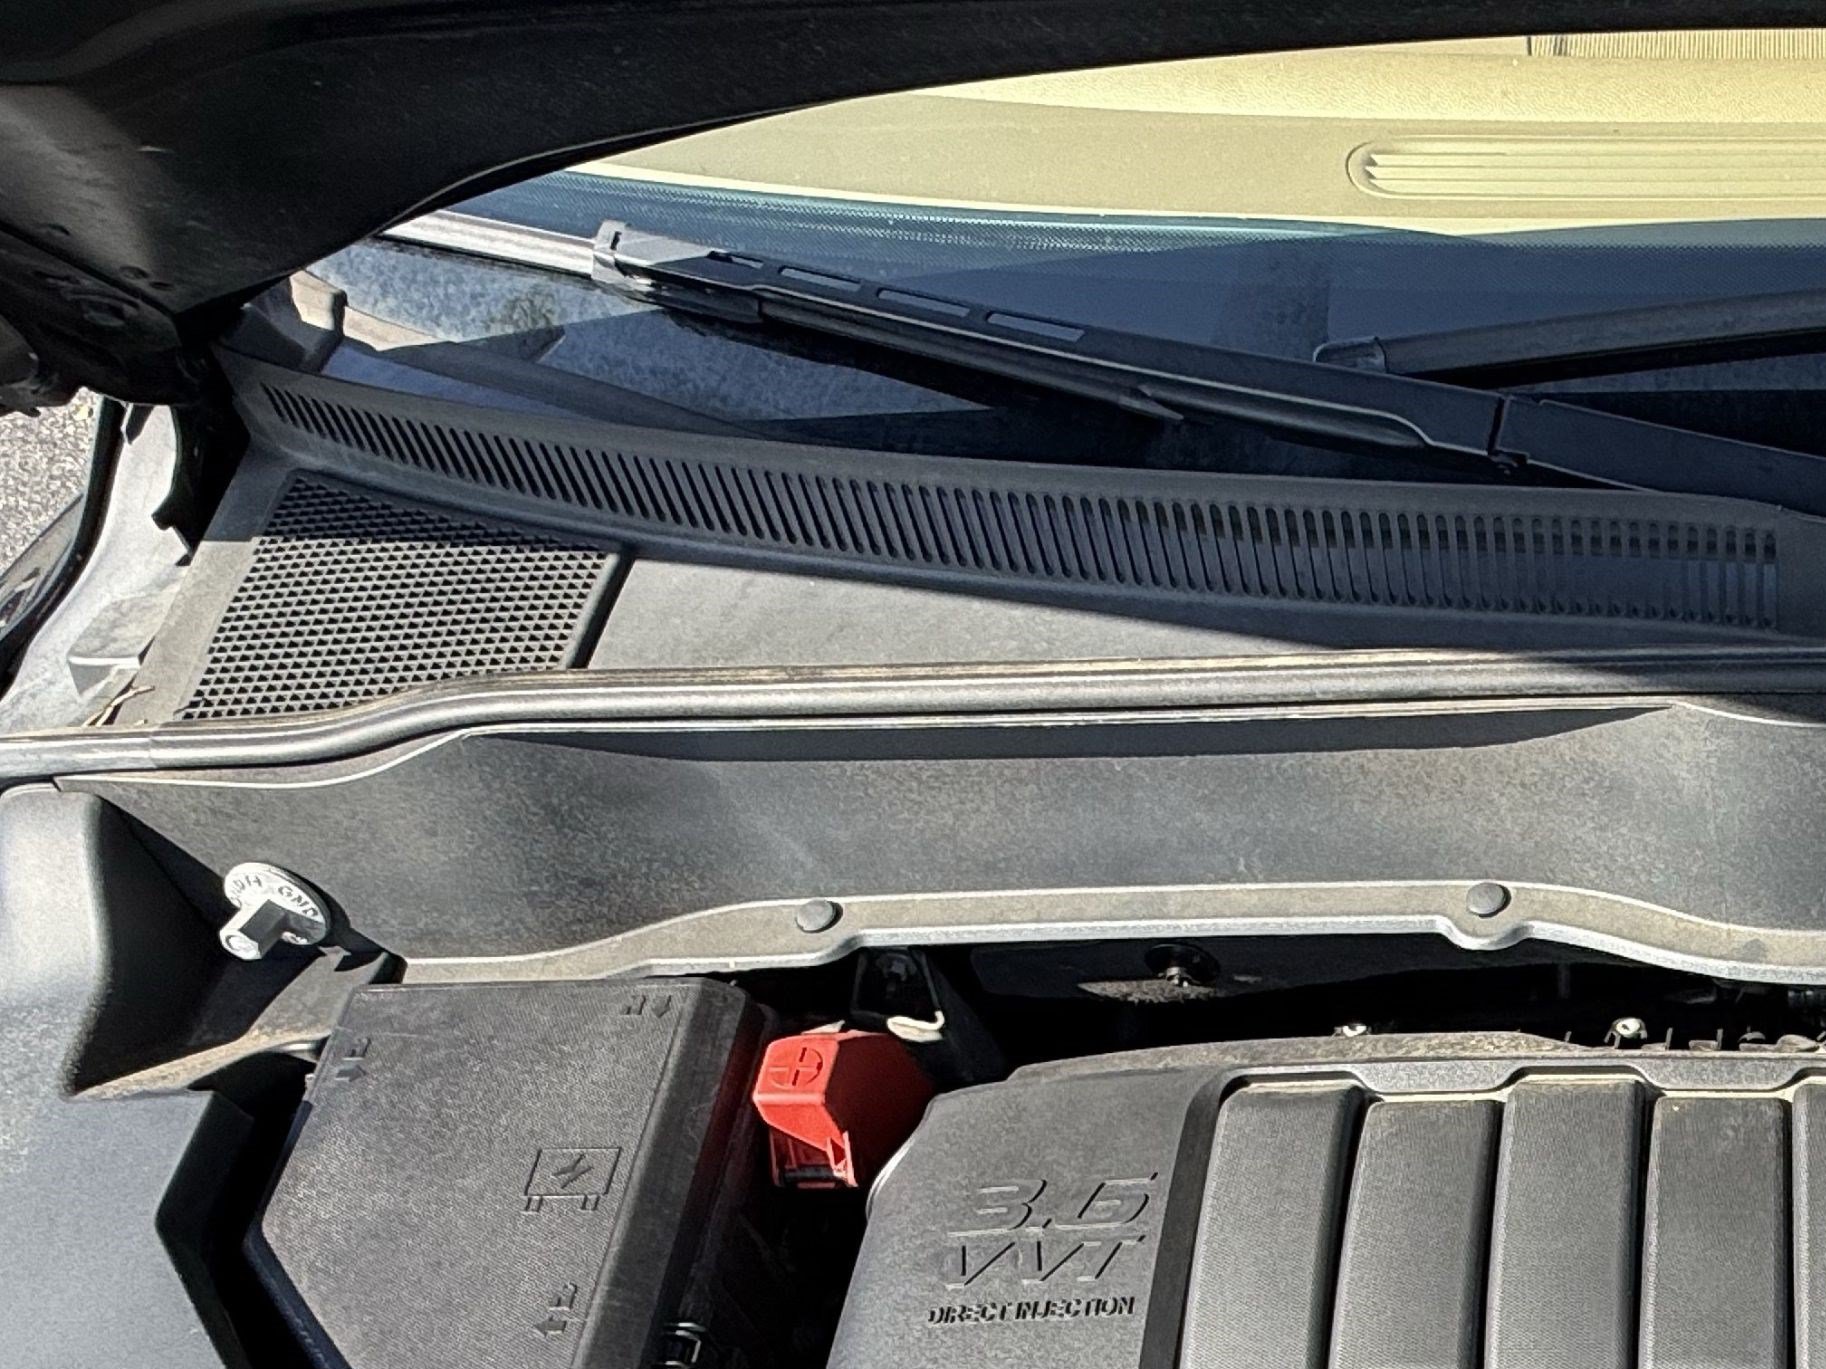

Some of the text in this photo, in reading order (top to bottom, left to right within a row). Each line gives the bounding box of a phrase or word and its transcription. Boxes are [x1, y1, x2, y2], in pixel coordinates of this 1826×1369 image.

[945, 1235, 1147, 1290] VVT
[928, 1296, 1136, 1324] DIRECT INJECTION
